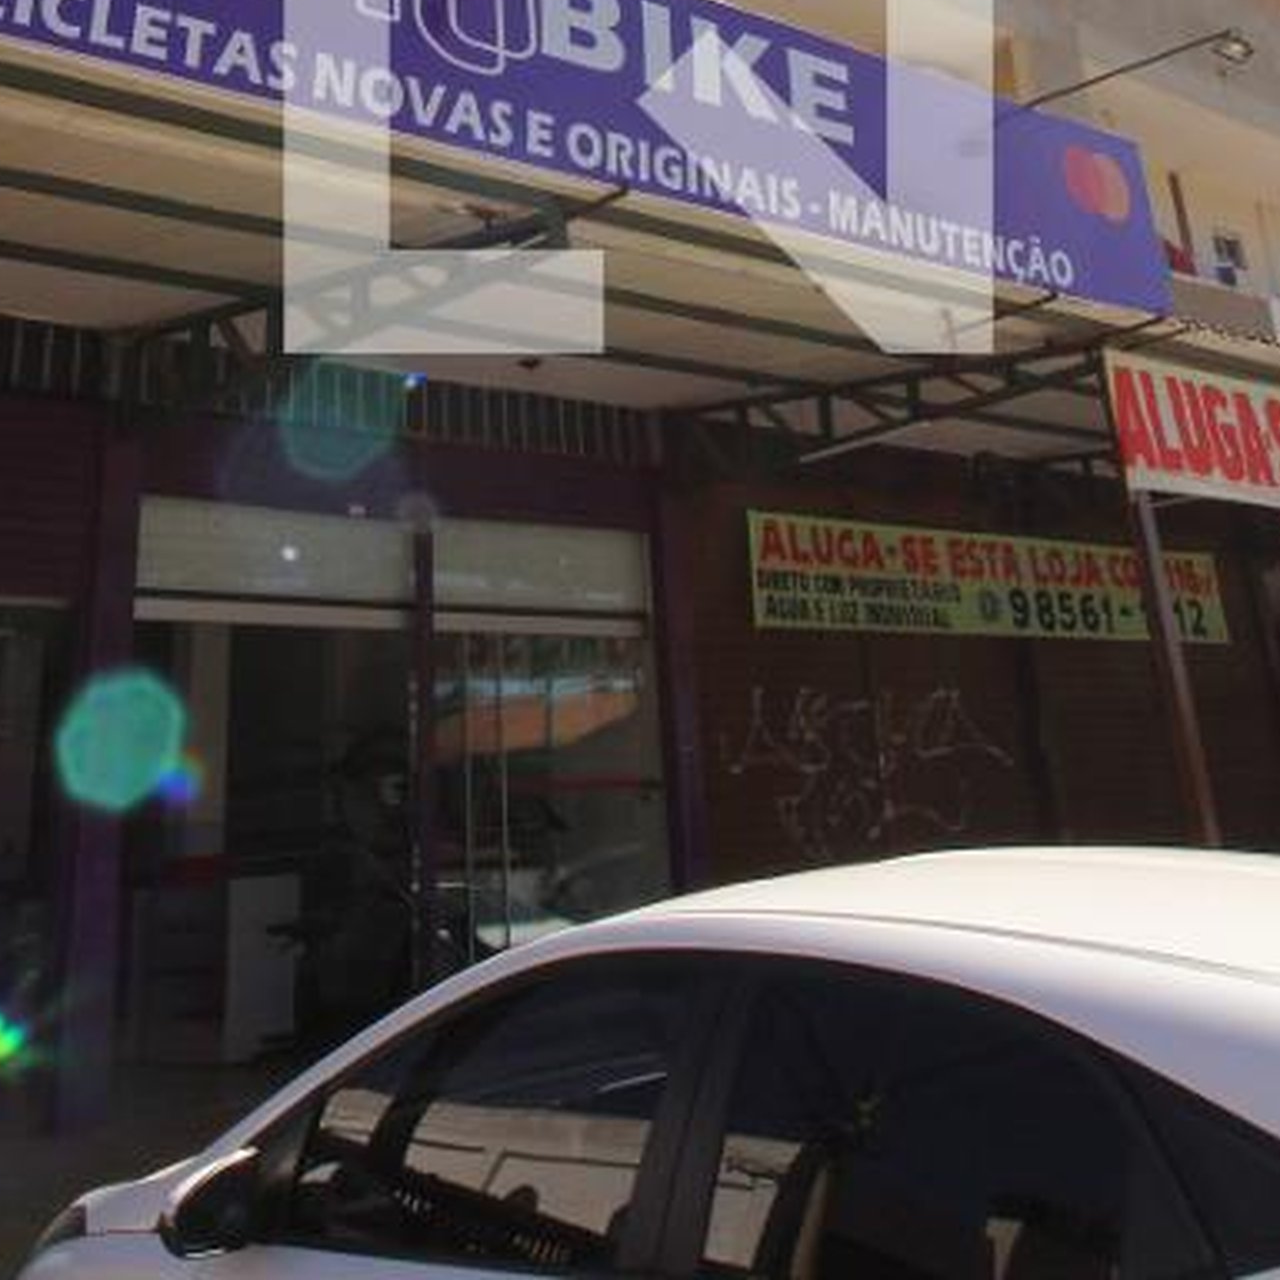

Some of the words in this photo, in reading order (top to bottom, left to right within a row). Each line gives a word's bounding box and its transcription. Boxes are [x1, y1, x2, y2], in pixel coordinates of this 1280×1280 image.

[312, 52, 515, 148] NOVAS
[526, 110, 556, 159] E
[565, 123, 803, 219] ORIGINAIS
[829, 190, 1074, 288] MANUTENÇÃO
[950, 536, 1015, 582] ESTA
[1028, 545, 1102, 588] LOJA
